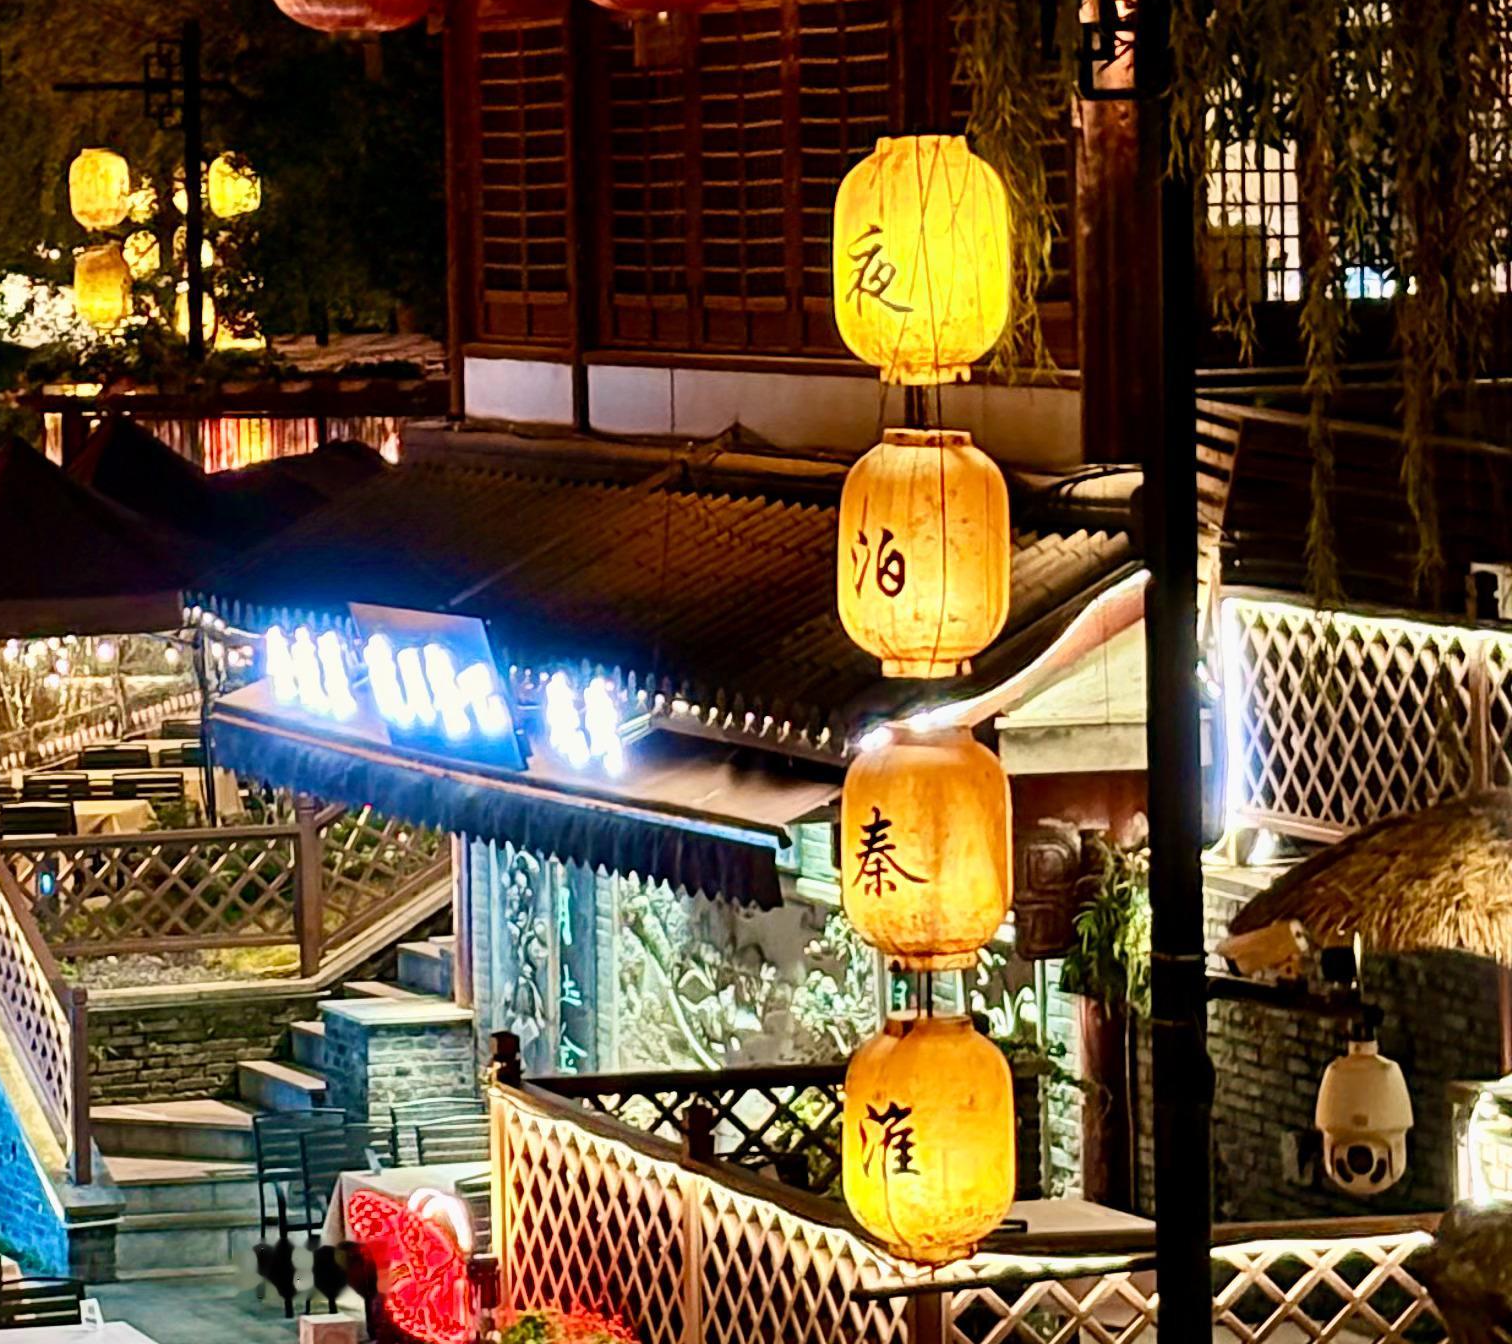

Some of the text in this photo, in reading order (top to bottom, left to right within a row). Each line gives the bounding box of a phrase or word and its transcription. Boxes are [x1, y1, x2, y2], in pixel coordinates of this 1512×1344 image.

[845, 223, 914, 317] 夜
[850, 526, 906, 599] 泊
[852, 805, 930, 898] 秦
[858, 1100, 921, 1182] 淮
